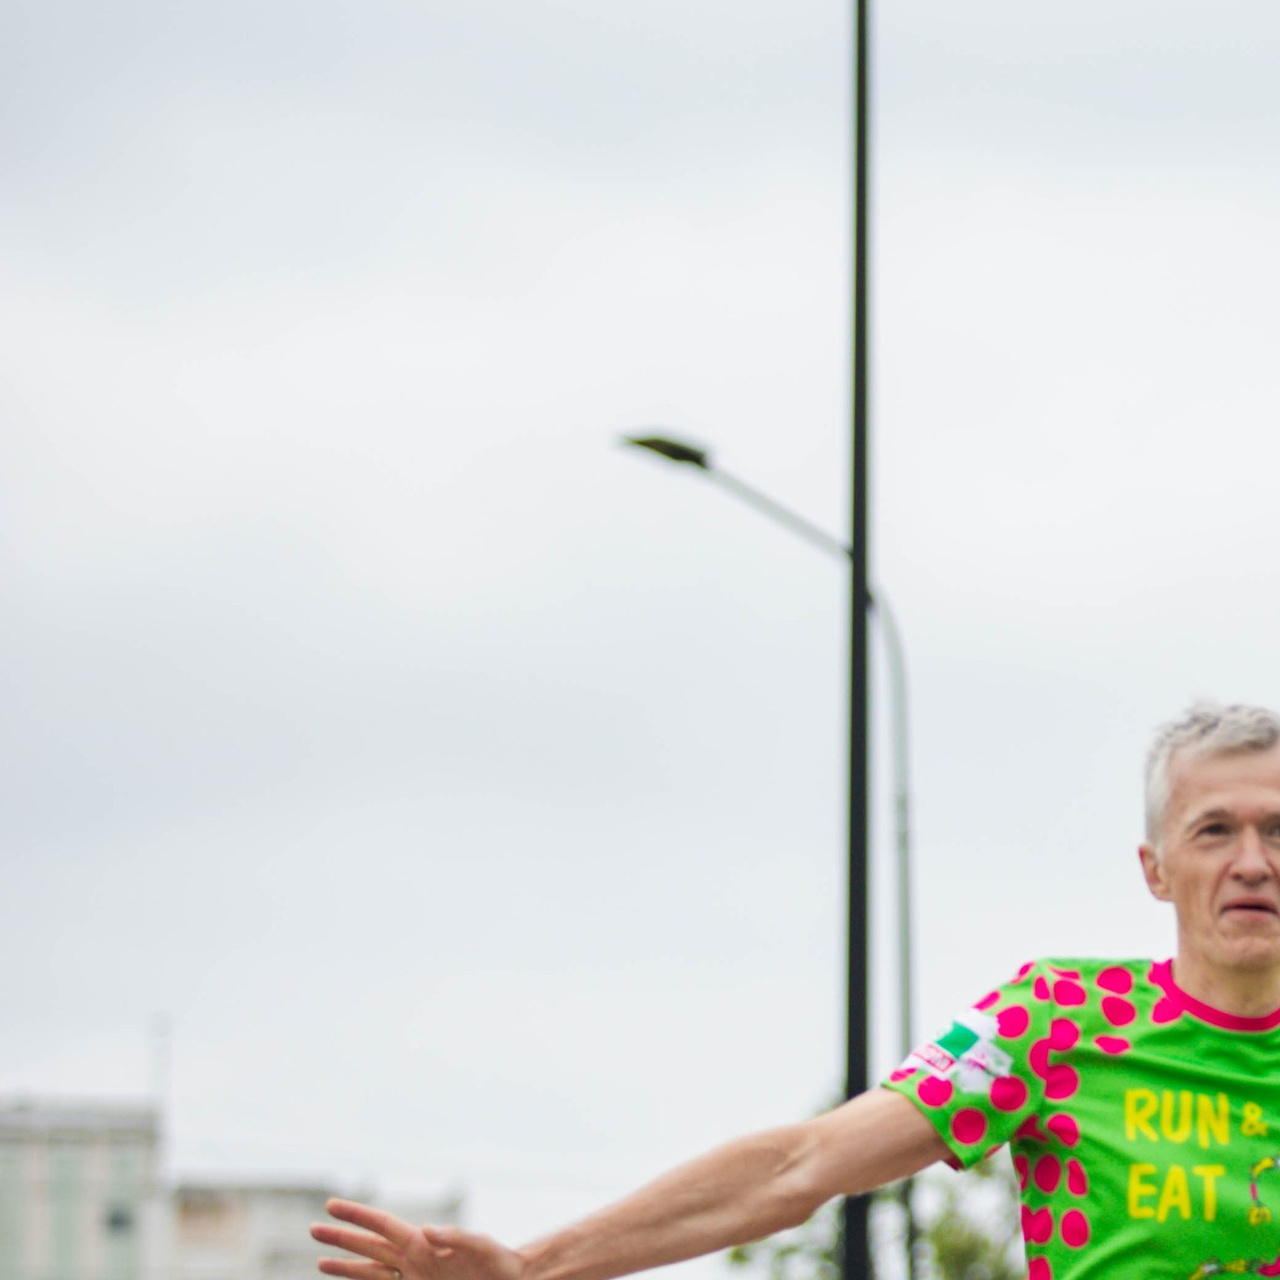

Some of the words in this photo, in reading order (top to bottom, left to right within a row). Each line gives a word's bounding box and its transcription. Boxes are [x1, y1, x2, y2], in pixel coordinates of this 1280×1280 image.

[1125, 1087, 1230, 1150] RUN
[1240, 1101, 1268, 1138] &
[1128, 1162, 1226, 1223] EAT
